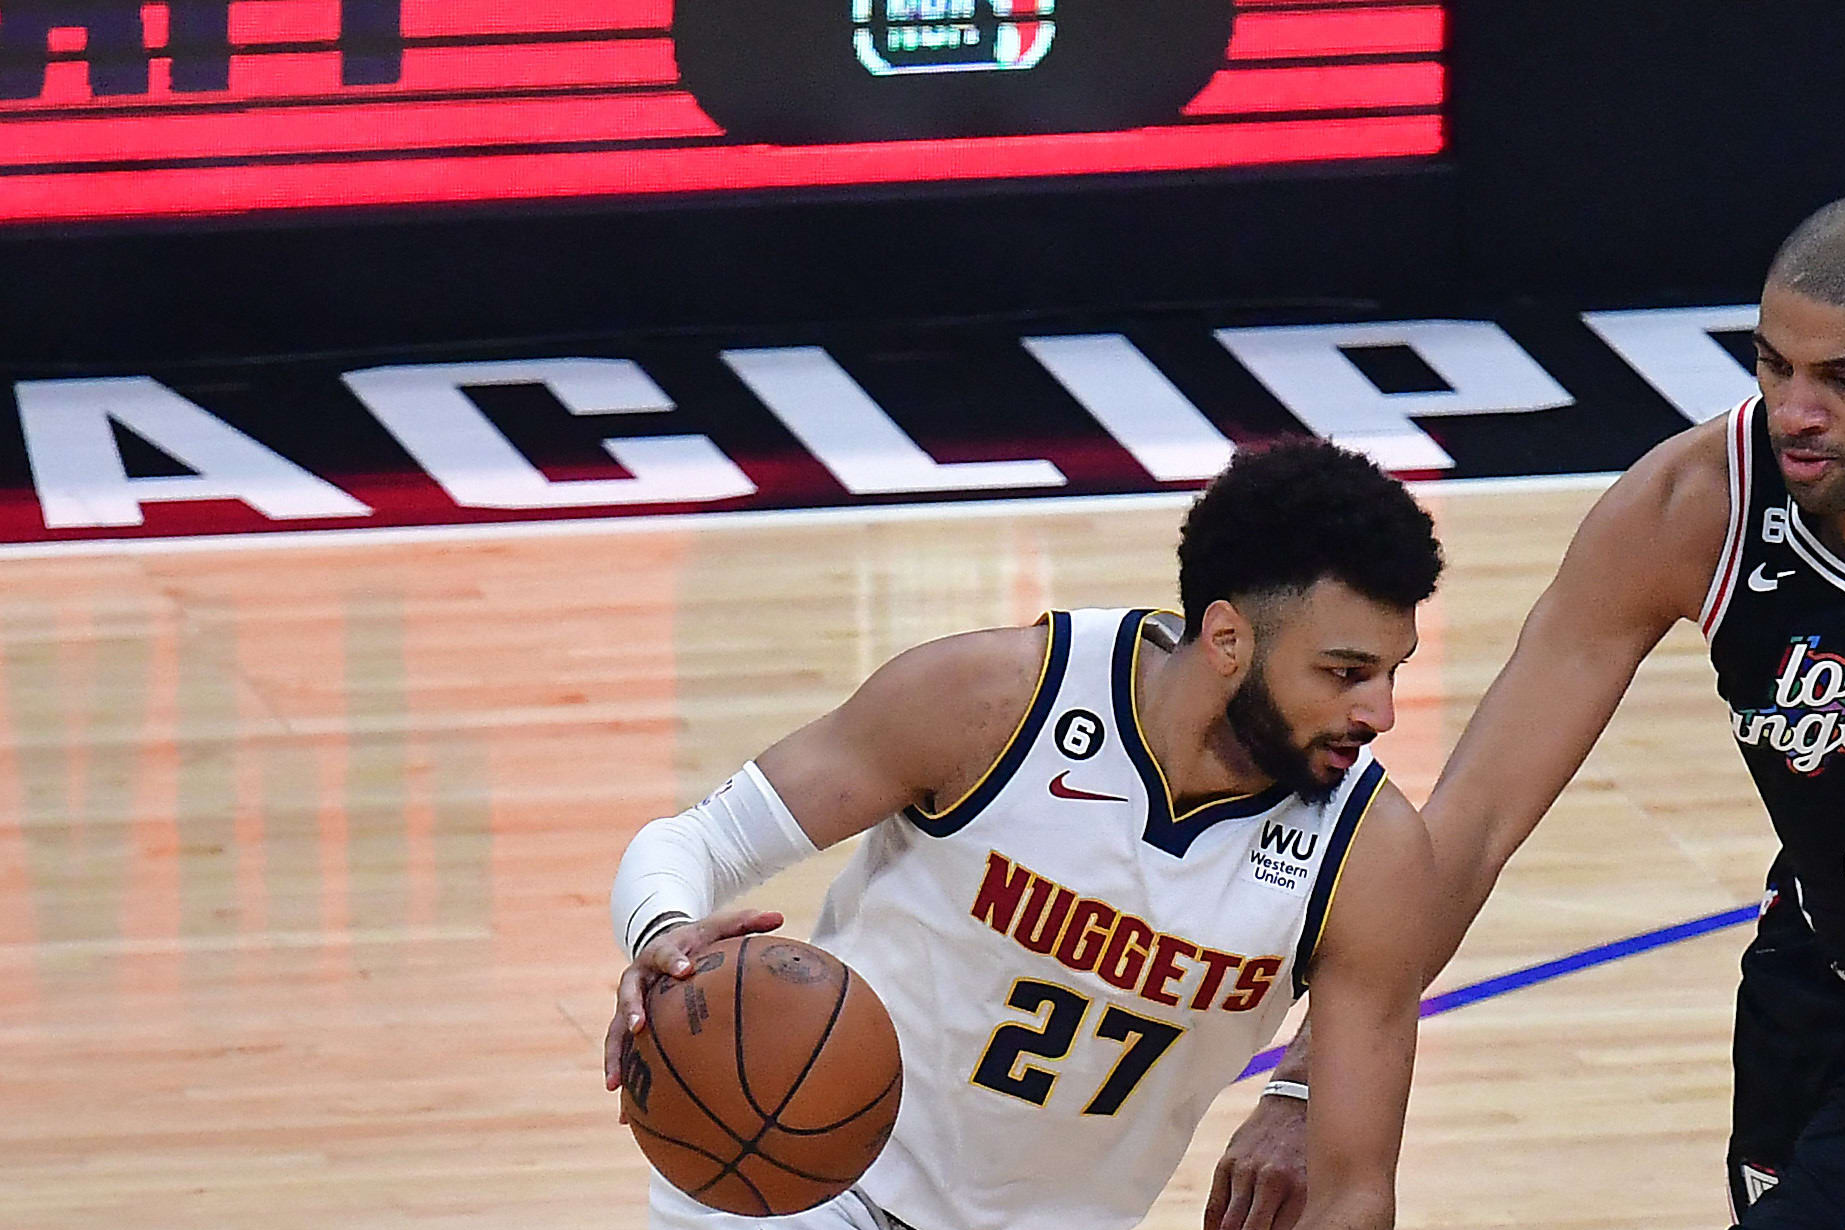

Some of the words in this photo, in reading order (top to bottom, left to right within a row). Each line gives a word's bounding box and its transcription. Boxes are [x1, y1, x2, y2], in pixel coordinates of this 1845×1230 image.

[1762, 507, 1787, 543] 6
[1062, 716, 1096, 755] 6
[1260, 819, 1319, 861] WU
[1250, 849, 1309, 879] Western
[1254, 866, 1296, 890] Union
[970, 850, 1285, 1012] NUGGETS
[969, 976, 1188, 1118] 27
